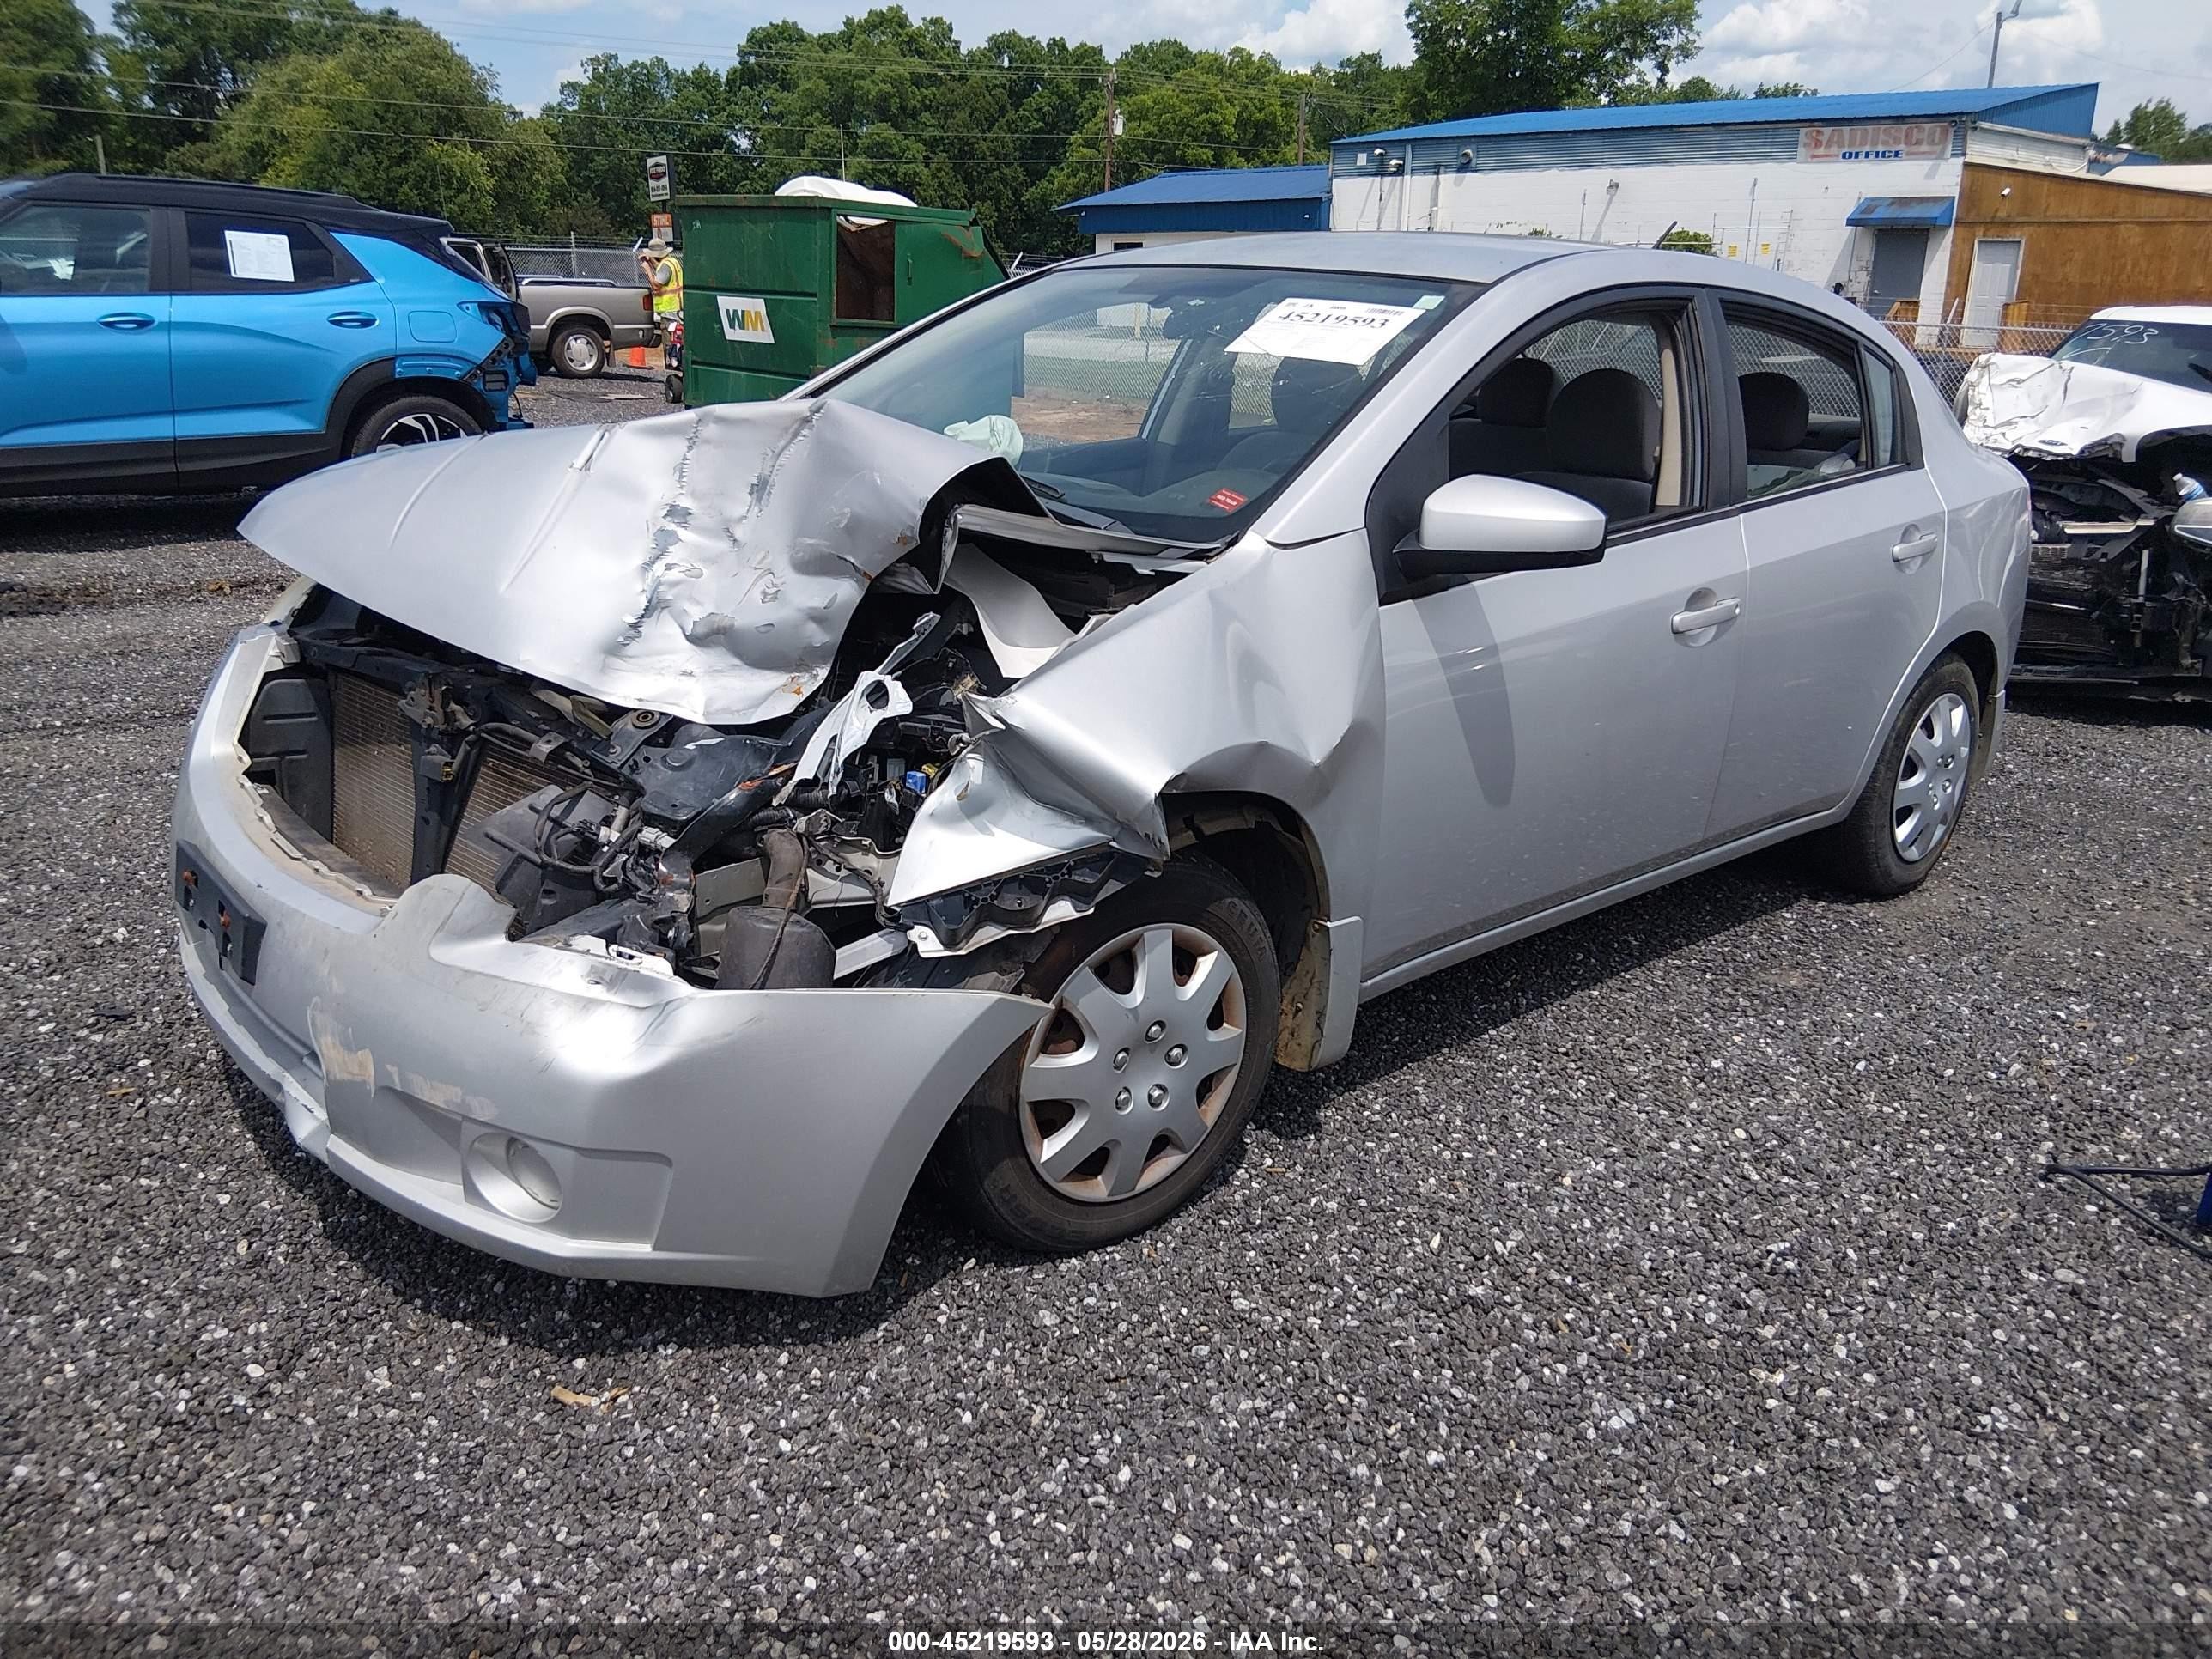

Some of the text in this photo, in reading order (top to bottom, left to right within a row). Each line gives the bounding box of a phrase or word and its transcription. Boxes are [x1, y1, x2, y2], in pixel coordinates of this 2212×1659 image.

[1804, 125, 1950, 149] SADISCO
[1841, 149, 1904, 160] OFFICE
[726, 309, 766, 331] WM
[1279, 311, 1389, 329] 45219593
